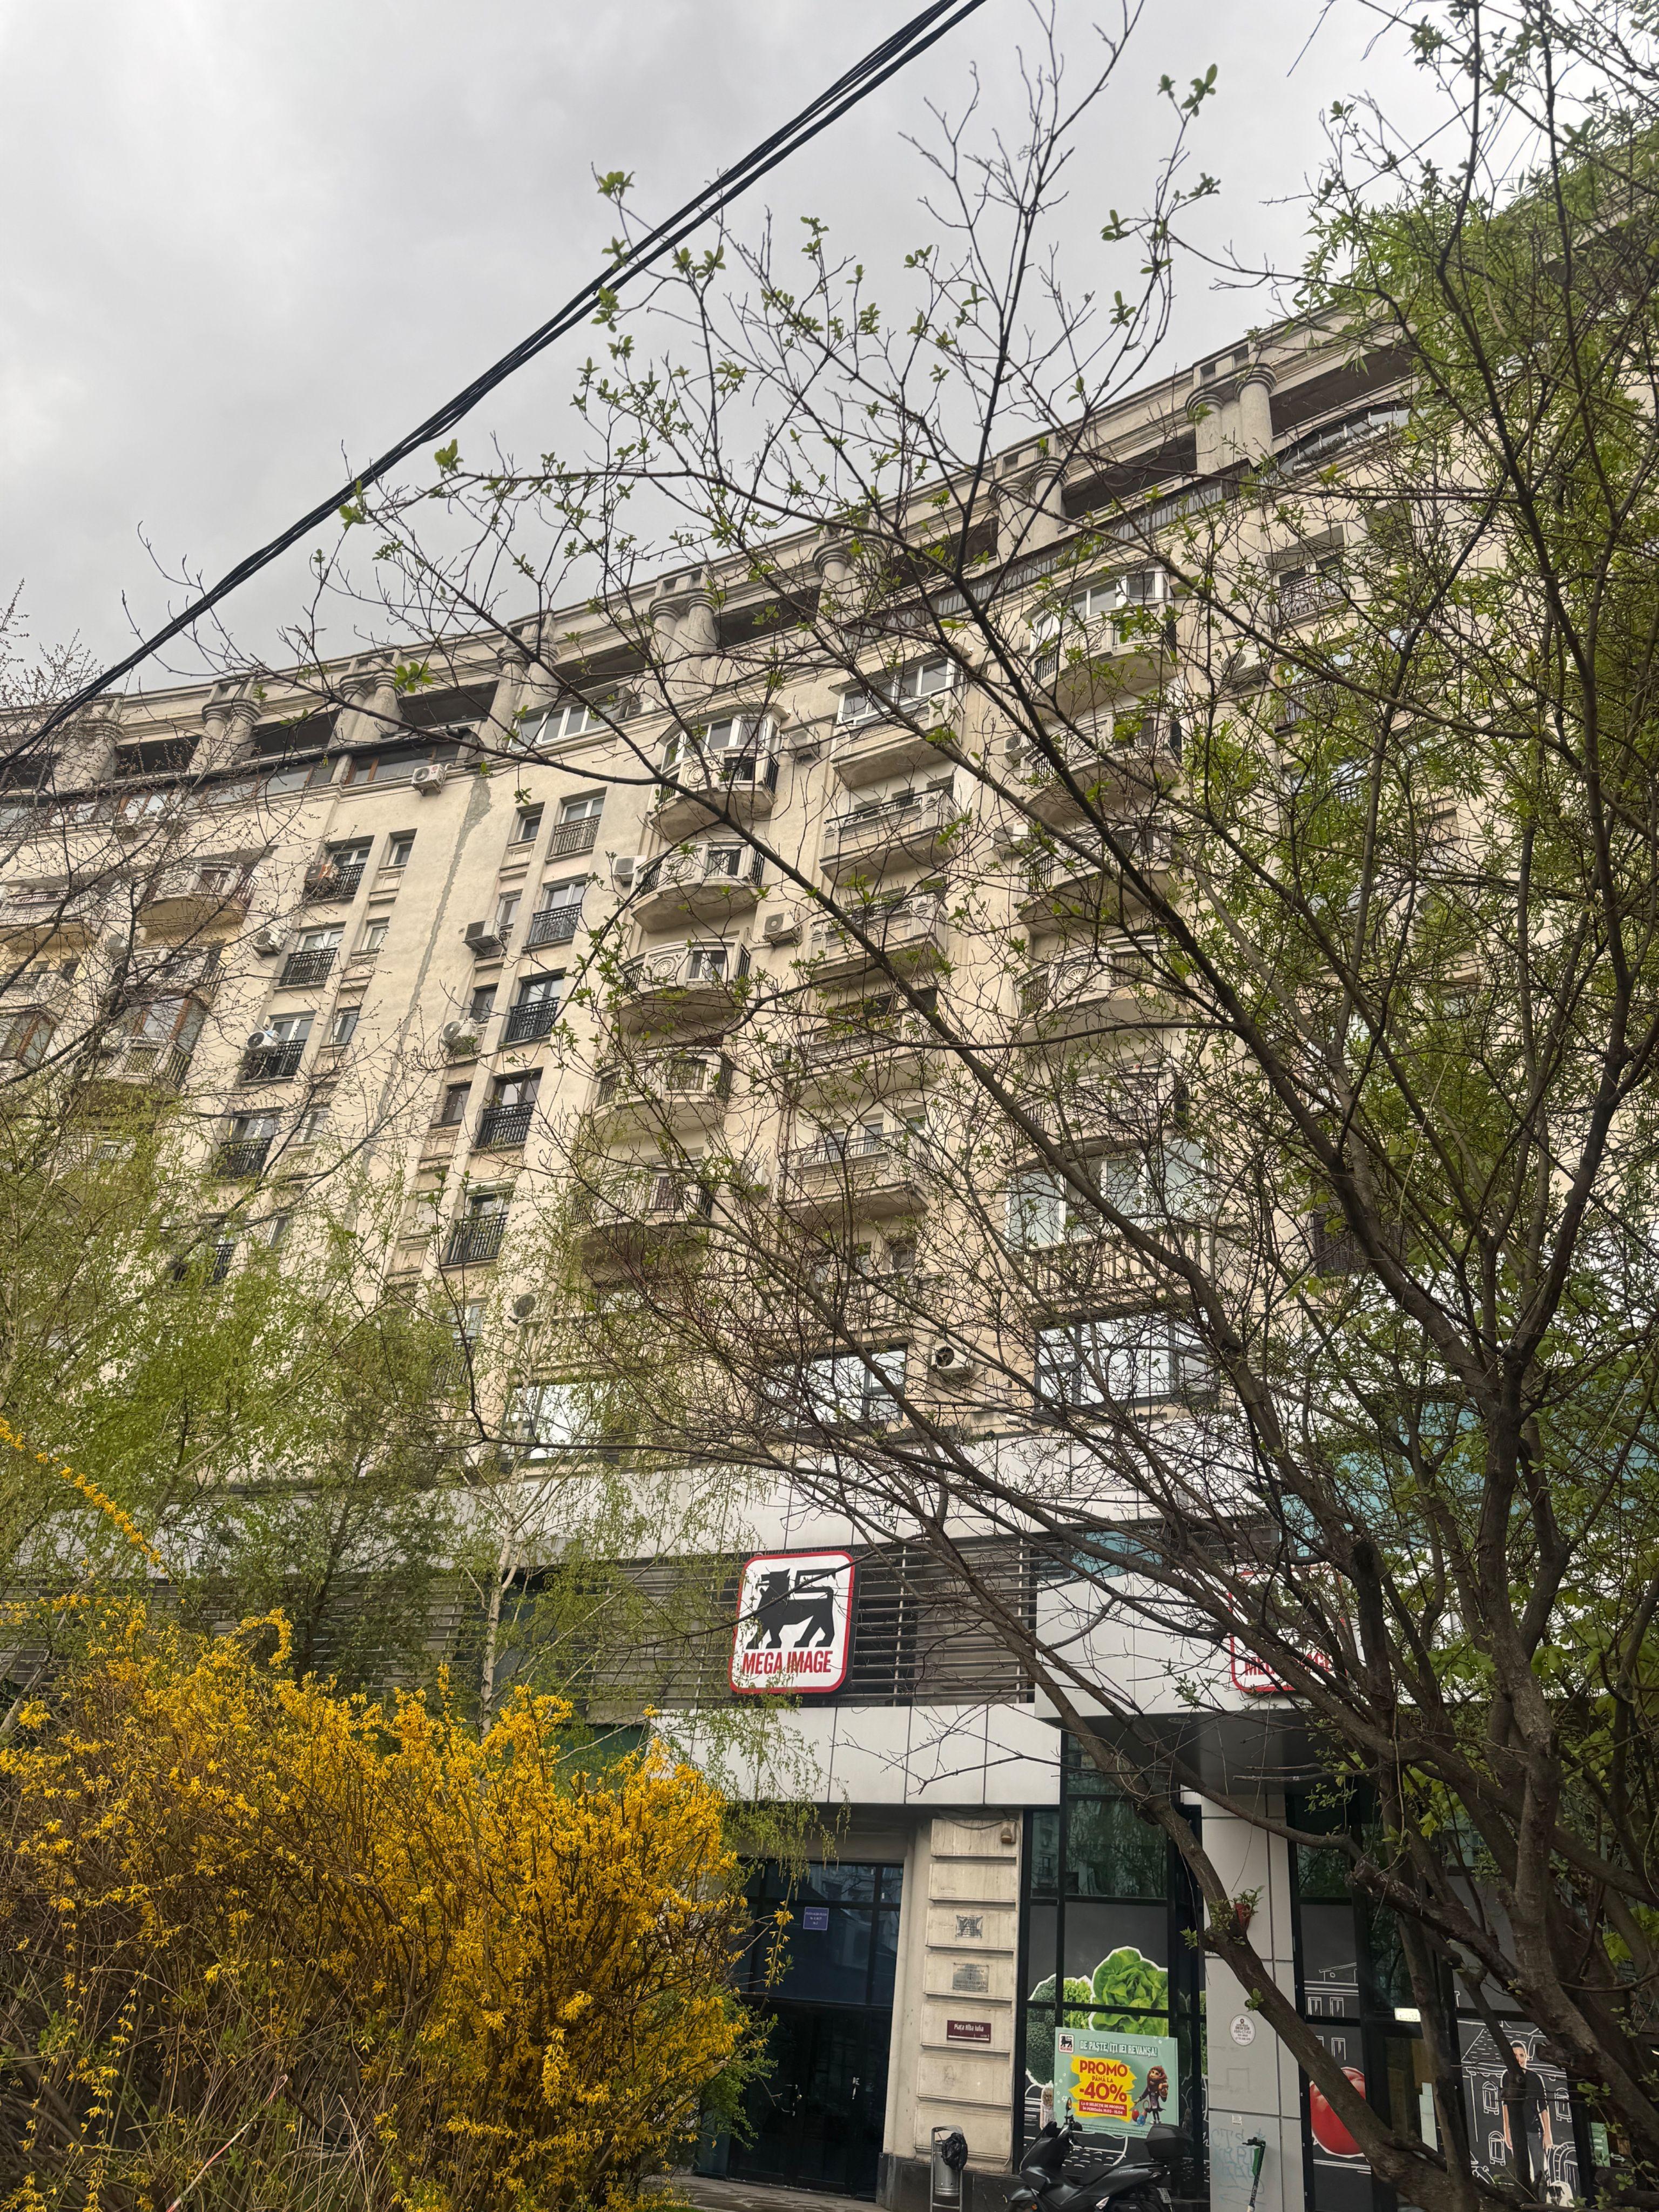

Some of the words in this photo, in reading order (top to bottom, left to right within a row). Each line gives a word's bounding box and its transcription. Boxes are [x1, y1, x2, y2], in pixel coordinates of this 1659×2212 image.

[742, 1652, 783, 1675] MEGA
[786, 1650, 833, 1674] IMAGE
[1080, 2040, 1087, 2050] DE
[1080, 2060, 1128, 2078] PROMO
[1080, 2081, 1128, 2102] -40%
